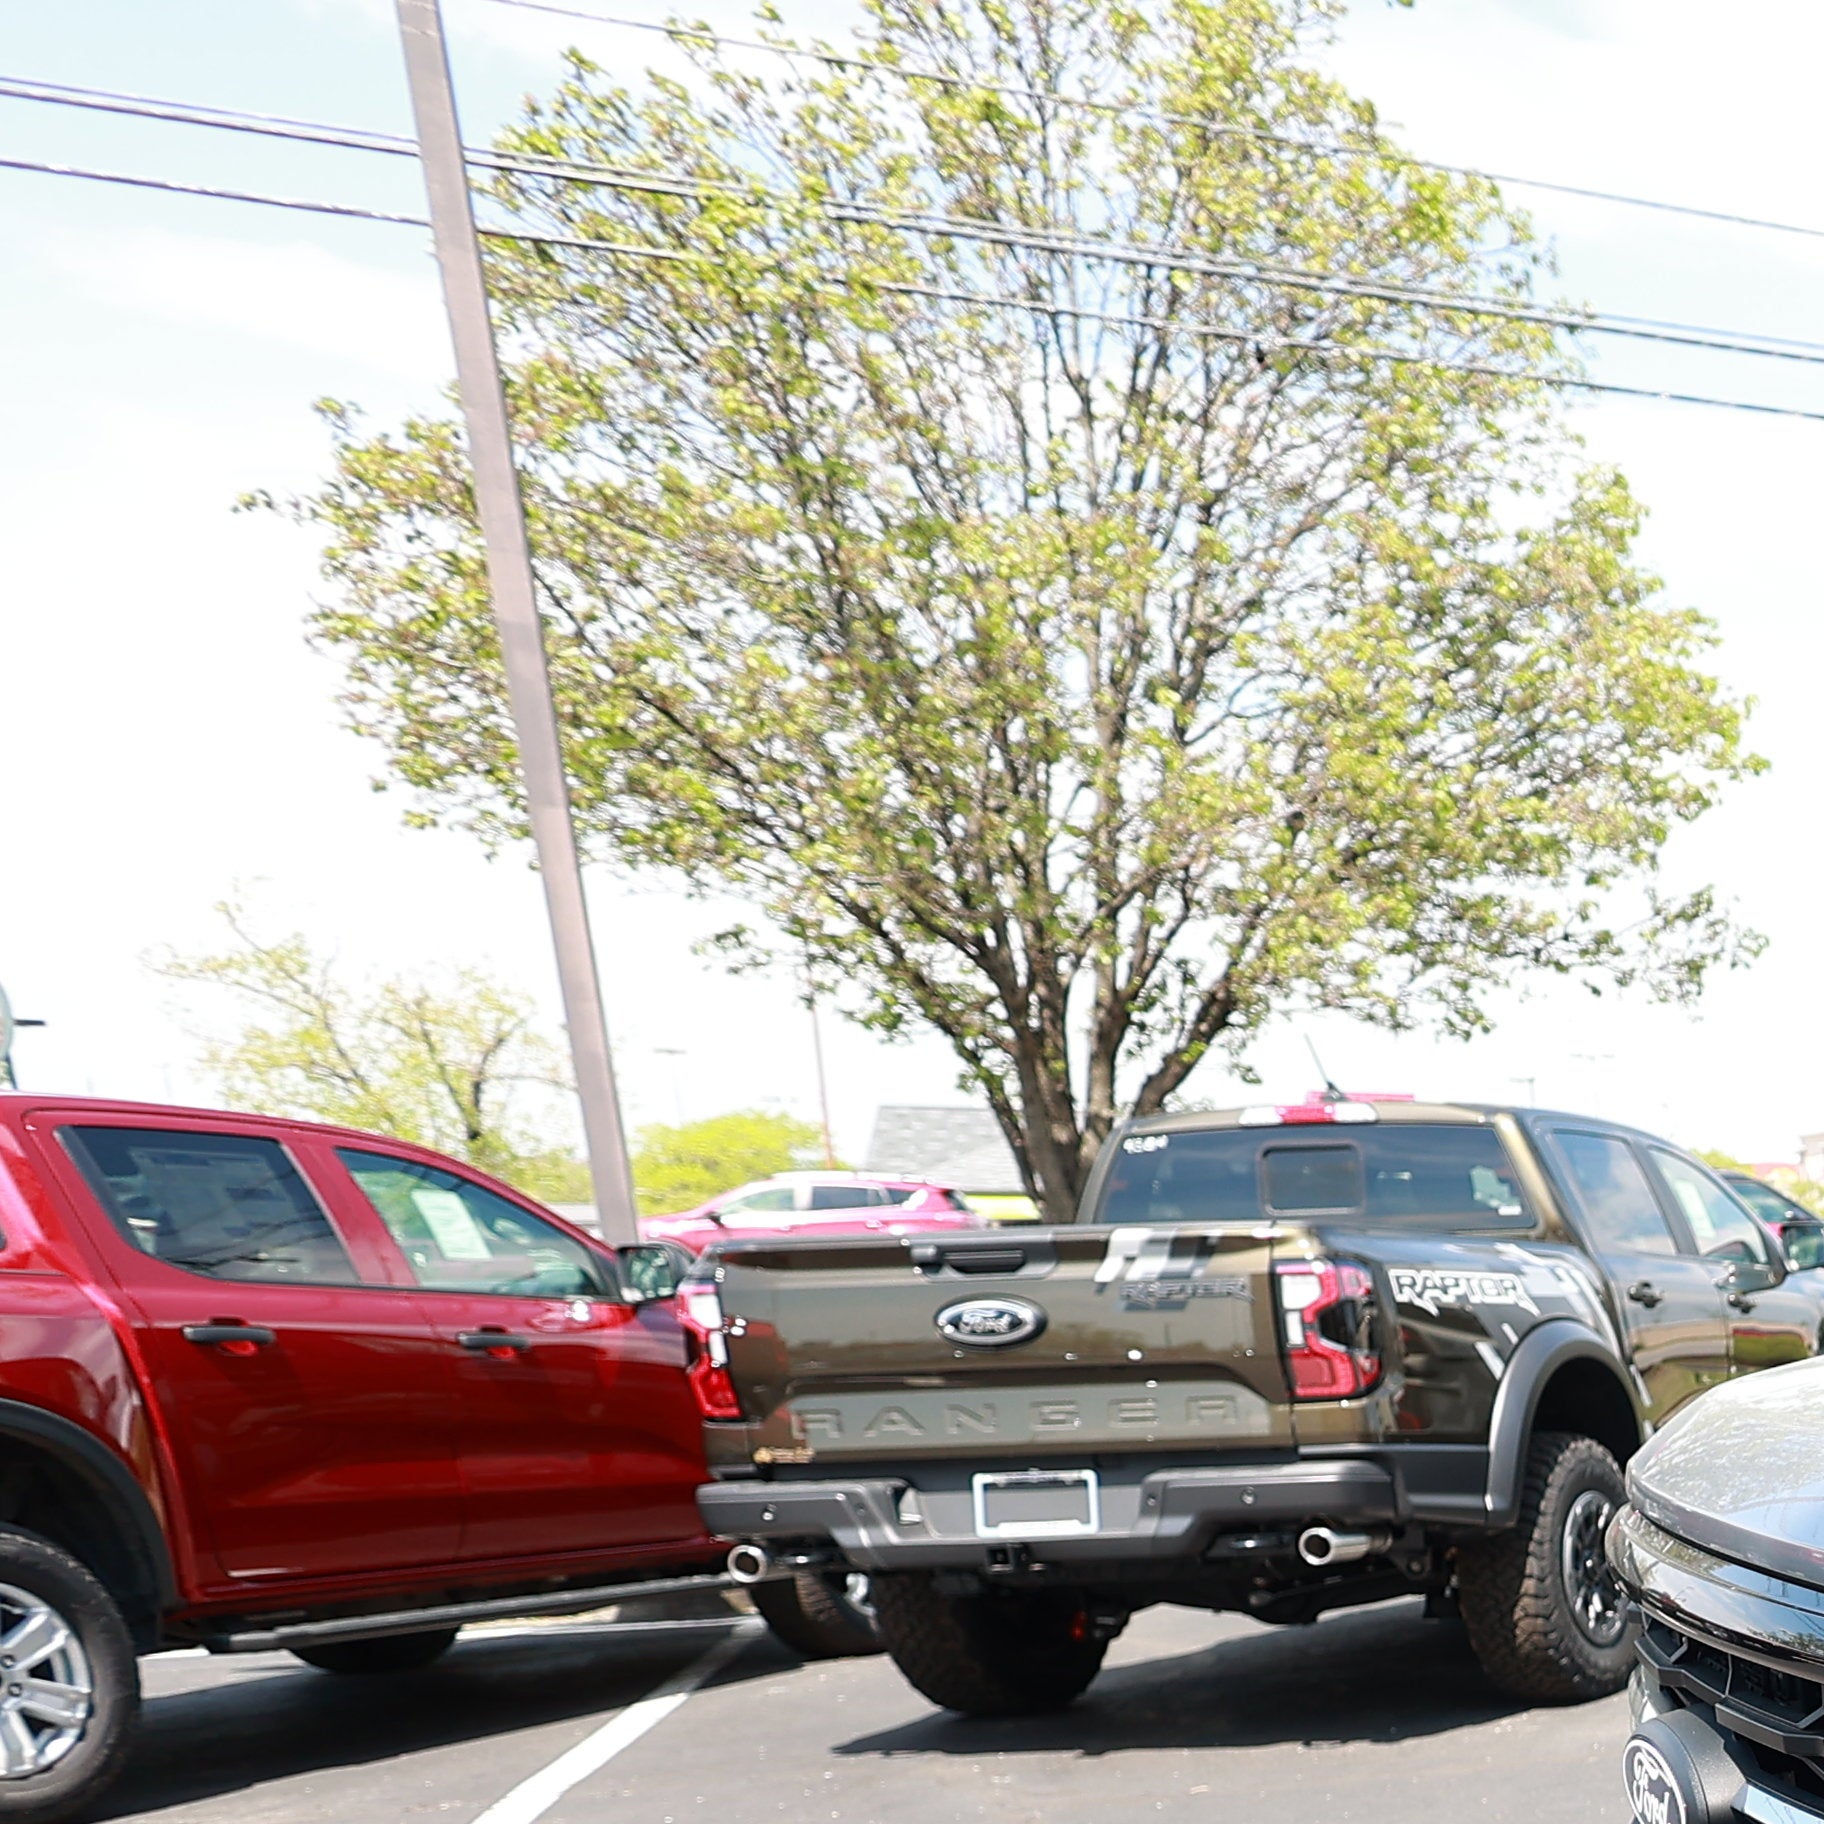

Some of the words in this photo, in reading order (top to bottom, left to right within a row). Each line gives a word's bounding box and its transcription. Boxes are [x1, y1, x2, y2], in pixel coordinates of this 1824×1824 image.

[1388, 1268, 1541, 1318] RAPTOR
[959, 1308, 1011, 1334] Ford
[792, 1393, 1239, 1440] RANGER
